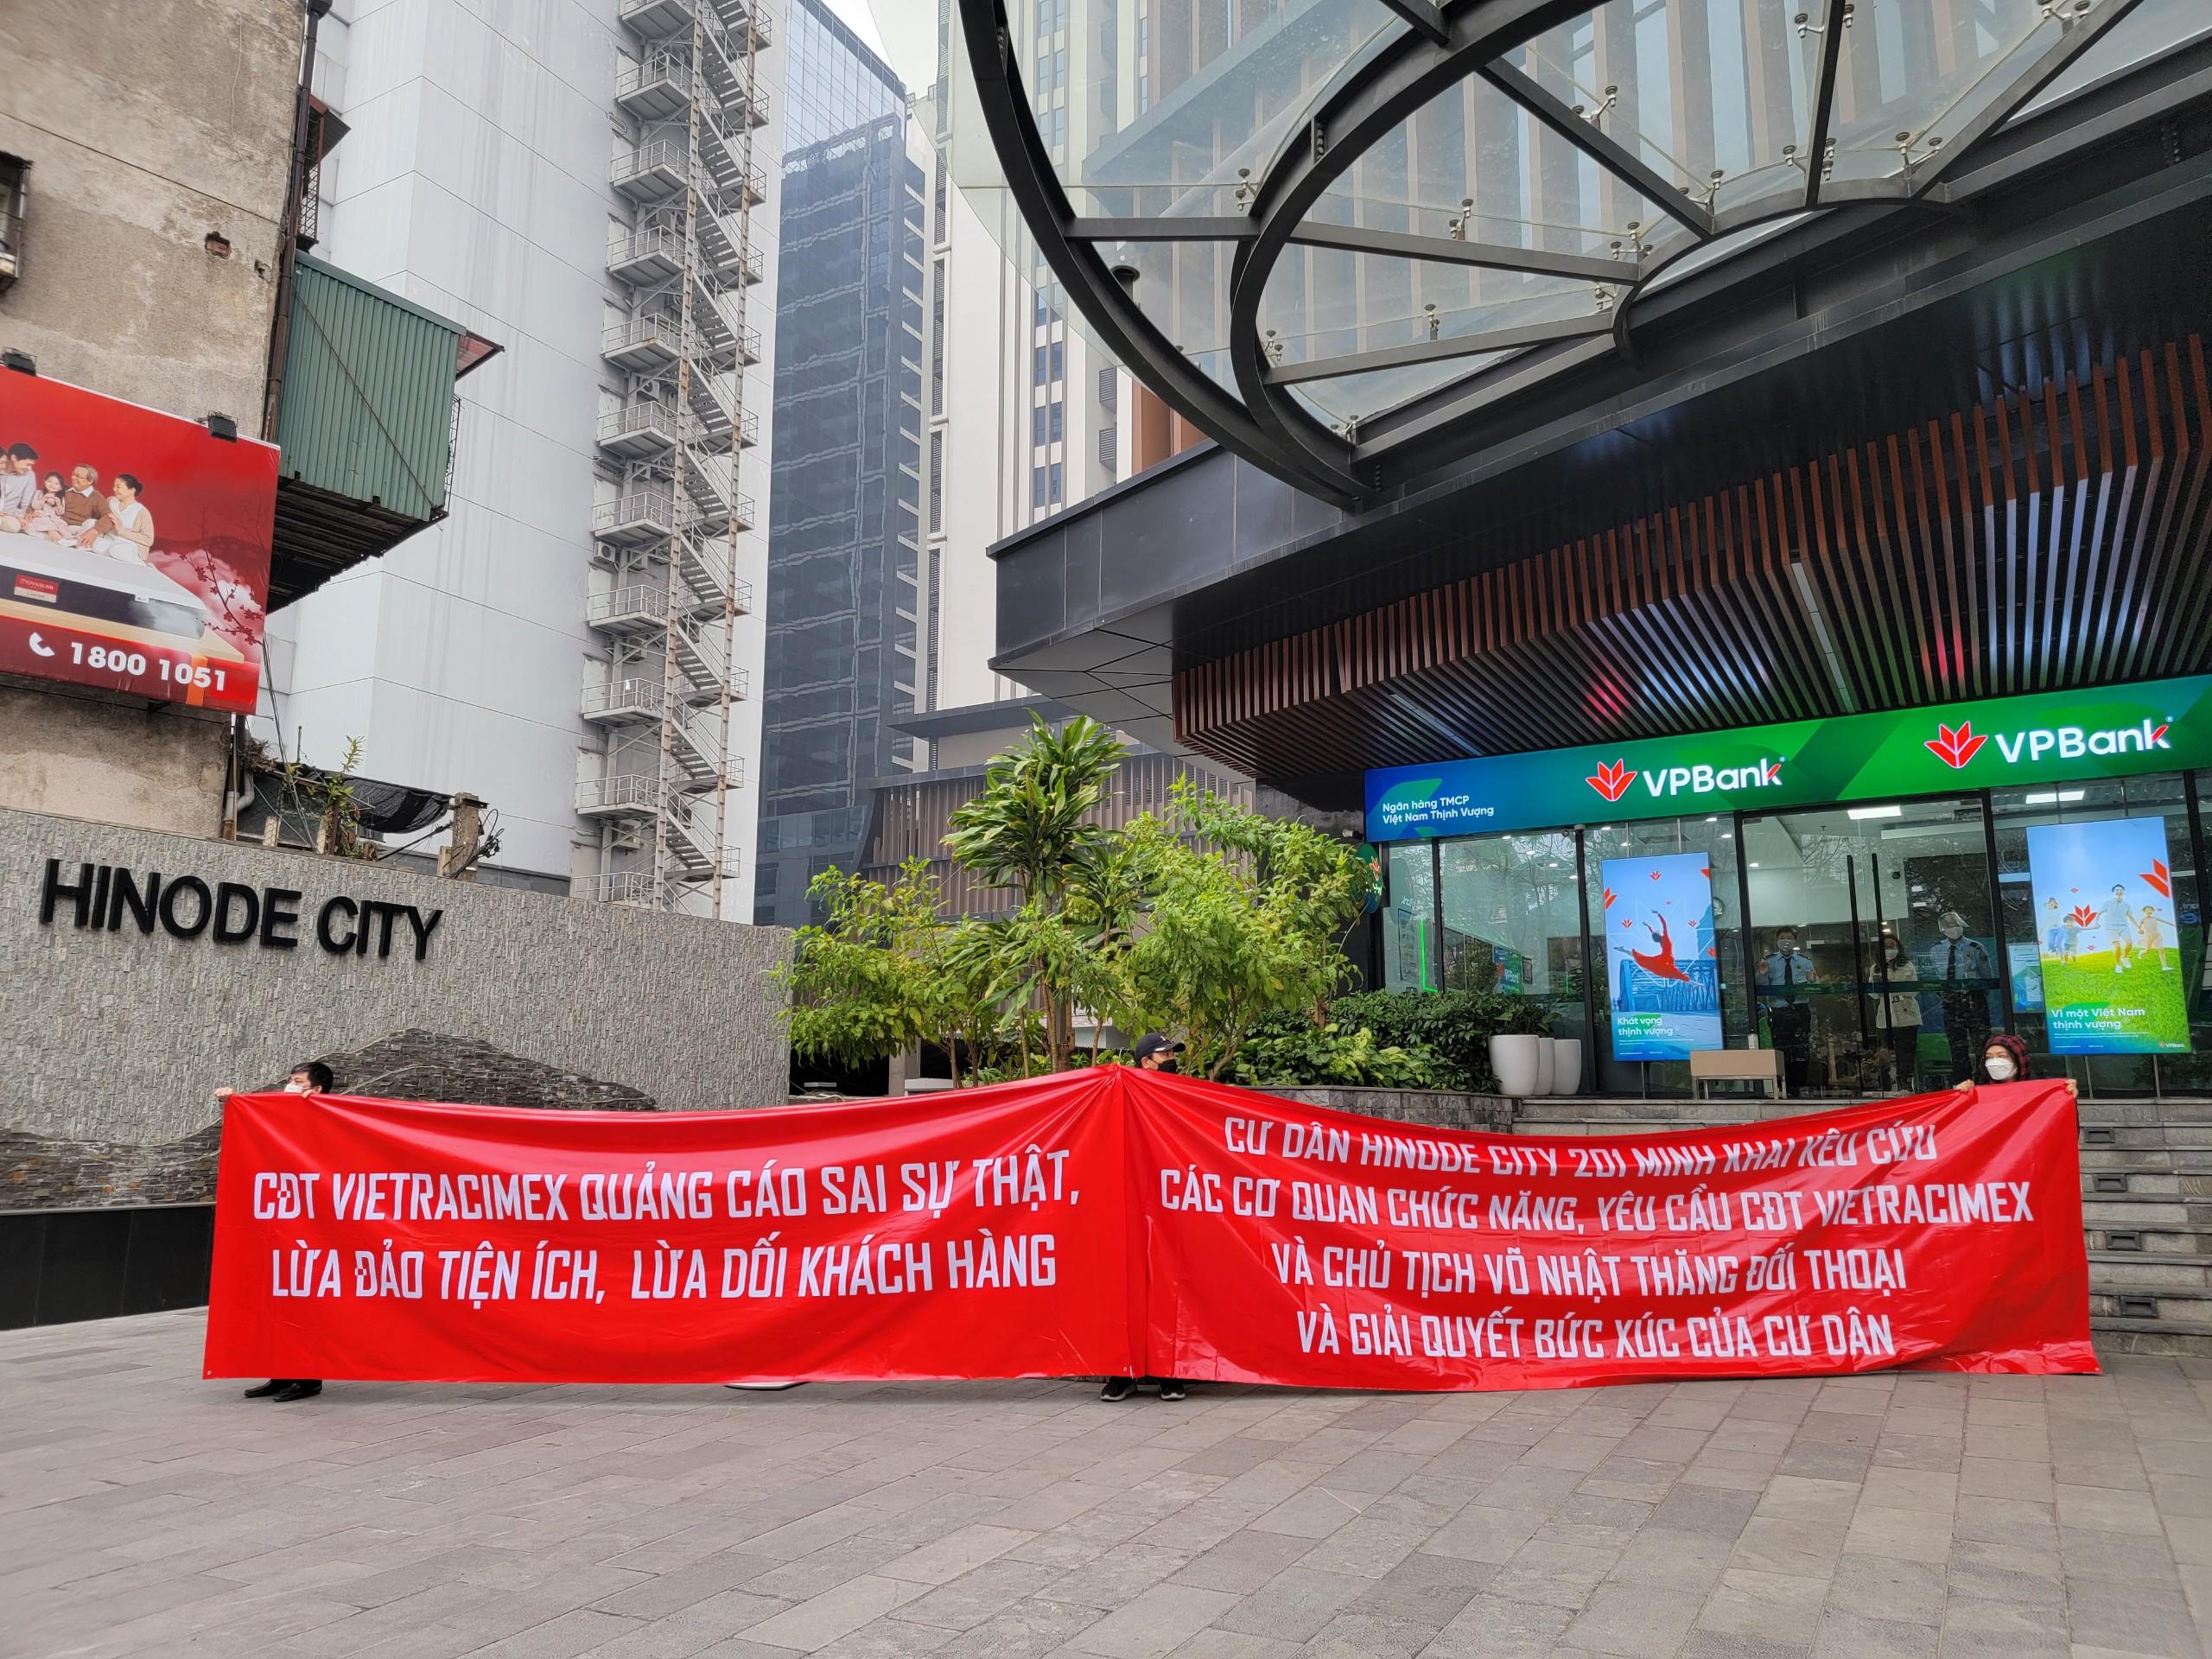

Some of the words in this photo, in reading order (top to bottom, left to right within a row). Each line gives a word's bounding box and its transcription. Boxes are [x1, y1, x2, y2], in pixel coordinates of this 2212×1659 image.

[71, 641, 146, 676] 1800
[159, 659, 226, 691] 1051
[1994, 718, 2171, 763] VPBank
[1643, 757, 1783, 797] VPBank
[1382, 802, 1408, 813] Ngân
[1412, 799, 1437, 810] hàng
[1440, 795, 1469, 806] TMCP
[1382, 814, 1402, 825] Việt
[1405, 812, 1427, 822] Nam
[1430, 809, 1458, 821] Thịnh
[1460, 807, 1494, 817] Vượng
[39, 858, 302, 947] HINODE
[316, 895, 444, 960] CITY
[1618, 1017, 1638, 1026] Khát
[1640, 1018, 1662, 1027] vọng
[1618, 1027, 1642, 1037] thịnh
[1643, 1027, 1673, 1036] vượng
[2053, 1020, 2082, 1031] thịnh
[2085, 1020, 2121, 1030] vượng
[2066, 1009, 2088, 1020] một
[2091, 1008, 2114, 1019] Việt
[2118, 1007, 2145, 1017] Nam
[1225, 1117, 1274, 1155] CƯ
[1282, 1122, 1350, 1163] DÂN
[1361, 1133, 1480, 1173] HINODE
[1487, 1146, 1556, 1176] CITY
[1567, 1148, 1626, 1177] 201
[1631, 1144, 1715, 1177] MINH
[1722, 1138, 1796, 1173] KHAI
[1798, 1128, 1859, 1166] KÊU
[1866, 1120, 1937, 1164] CỨU
[254, 1173, 320, 1219] CĐT
[333, 1173, 569, 1220] VIETRACIMEX
[580, 1161, 714, 1220] QUẢNG
[727, 1160, 806, 1217] CÁO
[821, 1165, 887, 1214] SAI
[901, 1160, 960, 1218] SỰ
[972, 1143, 1079, 1211] THẬT,
[1160, 1164, 1223, 1212] CÁC
[1232, 1176, 1281, 1217] CƠ
[1292, 1181, 1379, 1225] QUAN
[1387, 1185, 1478, 1229] CHỨC
[1490, 1191, 1584, 1235] NĂNG,
[1598, 1191, 1656, 1231] YÊU
[1665, 1183, 1732, 1231] CẦU
[1740, 1192, 1802, 1230] CĐT
[1813, 1181, 2034, 1226] VIETRACIMEX
[272, 1240, 340, 1297] LỪA
[355, 1239, 423, 1298] ĐẢO
[438, 1241, 520, 1309] TIỆN
[531, 1241, 605, 1304] ÍCH,
[631, 1240, 707, 1299] LỪA
[721, 1231, 788, 1298] DỐI
[798, 1234, 932, 1297] KHÁCH
[947, 1228, 1056, 1289] HÀNG
[1271, 1236, 1313, 1286] VÀ
[1324, 1240, 1390, 1288] CHỦ
[1402, 1251, 1476, 1299] TỊCH
[1484, 1248, 1529, 1294] VÕ
[1537, 1249, 1620, 1303] NHẬT
[1630, 1249, 1738, 1296] THĂNG
[1746, 1242, 1796, 1292] ĐỐI
[1804, 1249, 1906, 1296] THOẠI
[1297, 1303, 1340, 1354] VÀ
[1349, 1304, 1413, 1356] GIẢI
[1421, 1306, 1524, 1357] QUYẾT
[1534, 1312, 1604, 1358] BỨC
[1615, 1312, 1680, 1358] XÚC
[1687, 1306, 1758, 1357] CỦA
[1764, 1315, 1812, 1356] CƯ
[1822, 1306, 1895, 1356] DÂN
